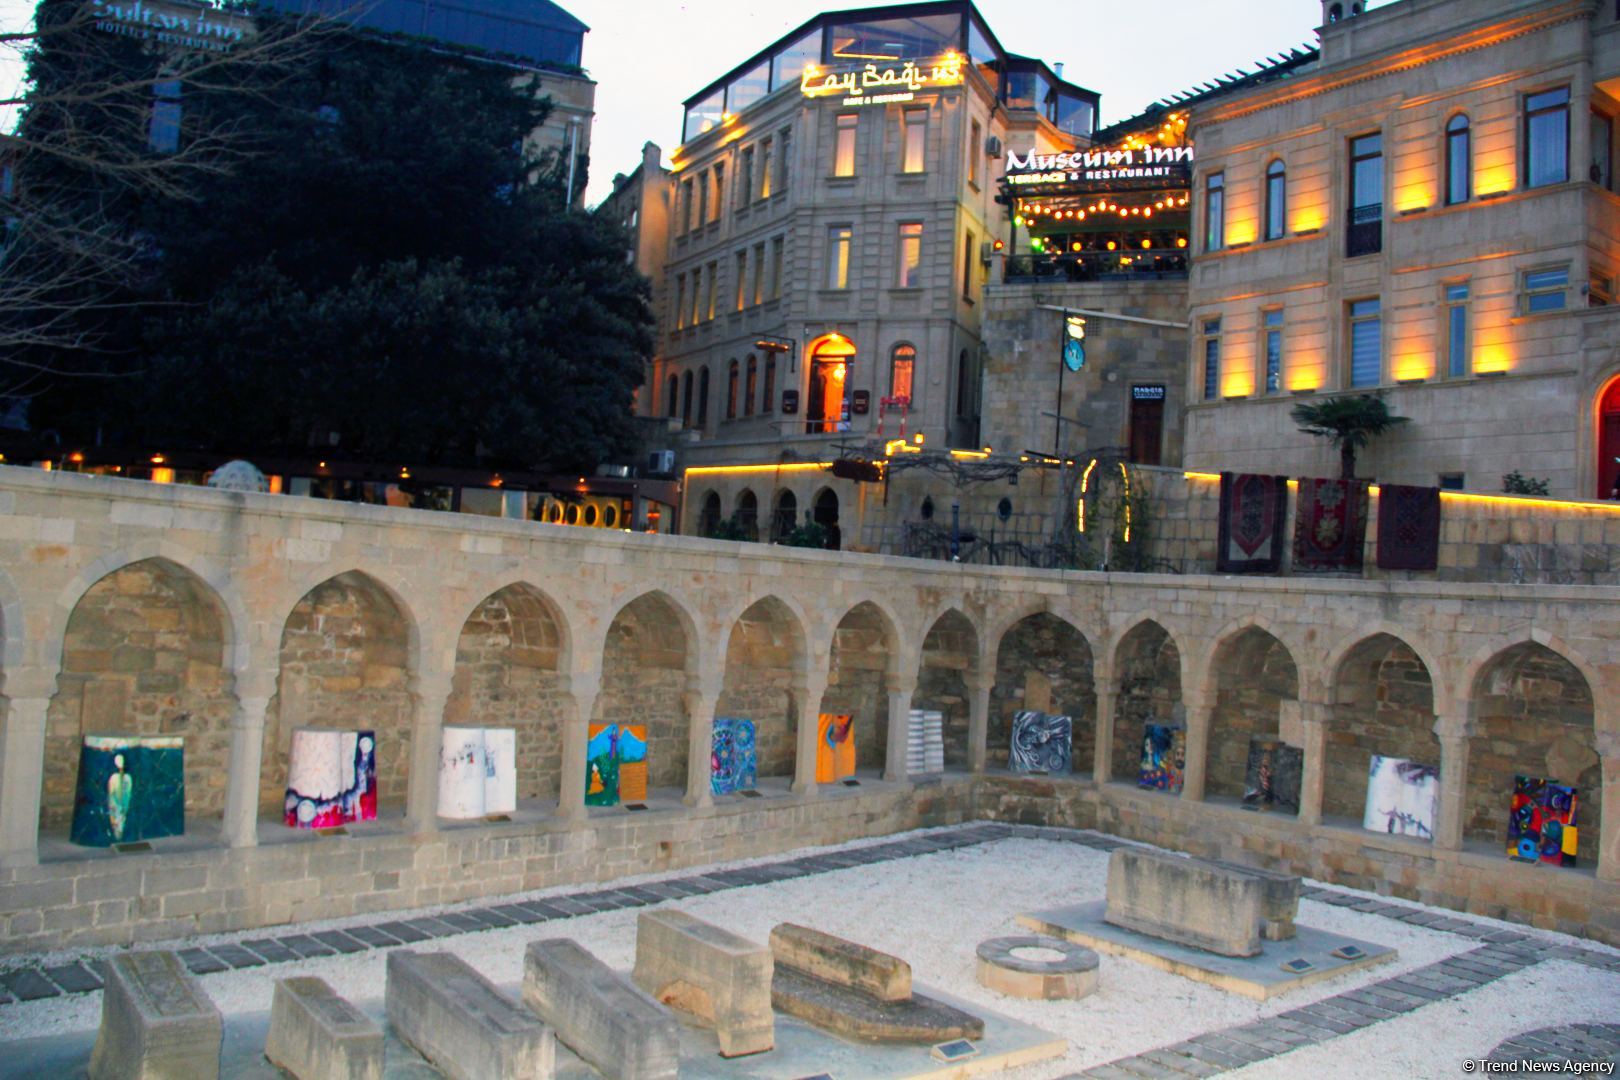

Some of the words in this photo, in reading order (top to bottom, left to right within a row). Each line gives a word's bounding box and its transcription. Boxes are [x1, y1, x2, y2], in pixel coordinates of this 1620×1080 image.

[196, 15, 243, 41] inn
[1005, 147, 1134, 171] Museum
[1144, 145, 1194, 164] inn
[1007, 172, 1066, 185] TERRACE
[1070, 171, 1079, 181] &
[1085, 167, 1171, 181] RESTAURANT
